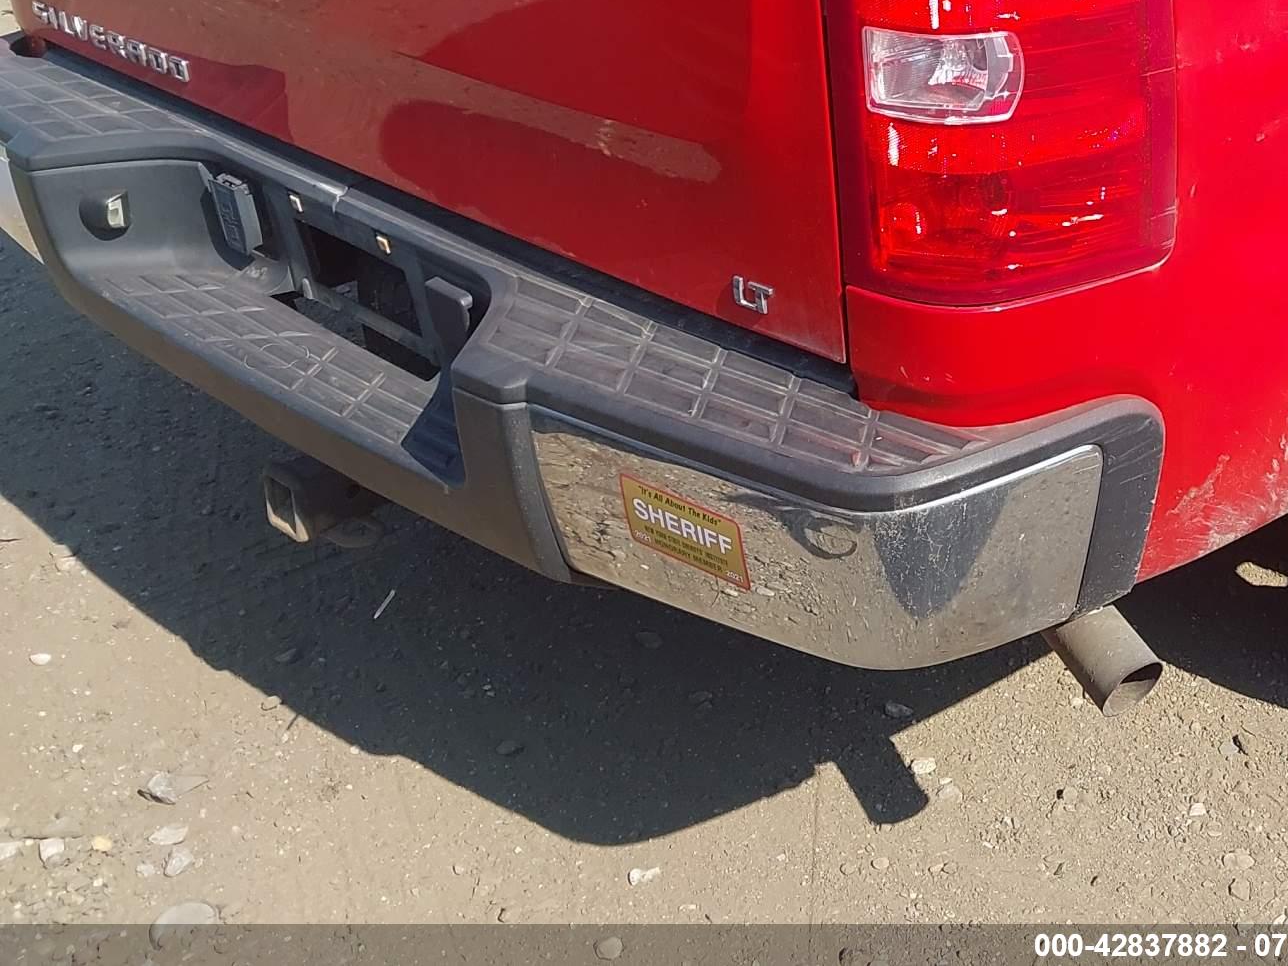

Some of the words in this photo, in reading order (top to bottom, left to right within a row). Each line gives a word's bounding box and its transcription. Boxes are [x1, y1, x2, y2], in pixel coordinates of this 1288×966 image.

[32, 0, 190, 82] SILVERADO
[733, 275, 774, 314] LT
[632, 498, 732, 555] SHERIFF
